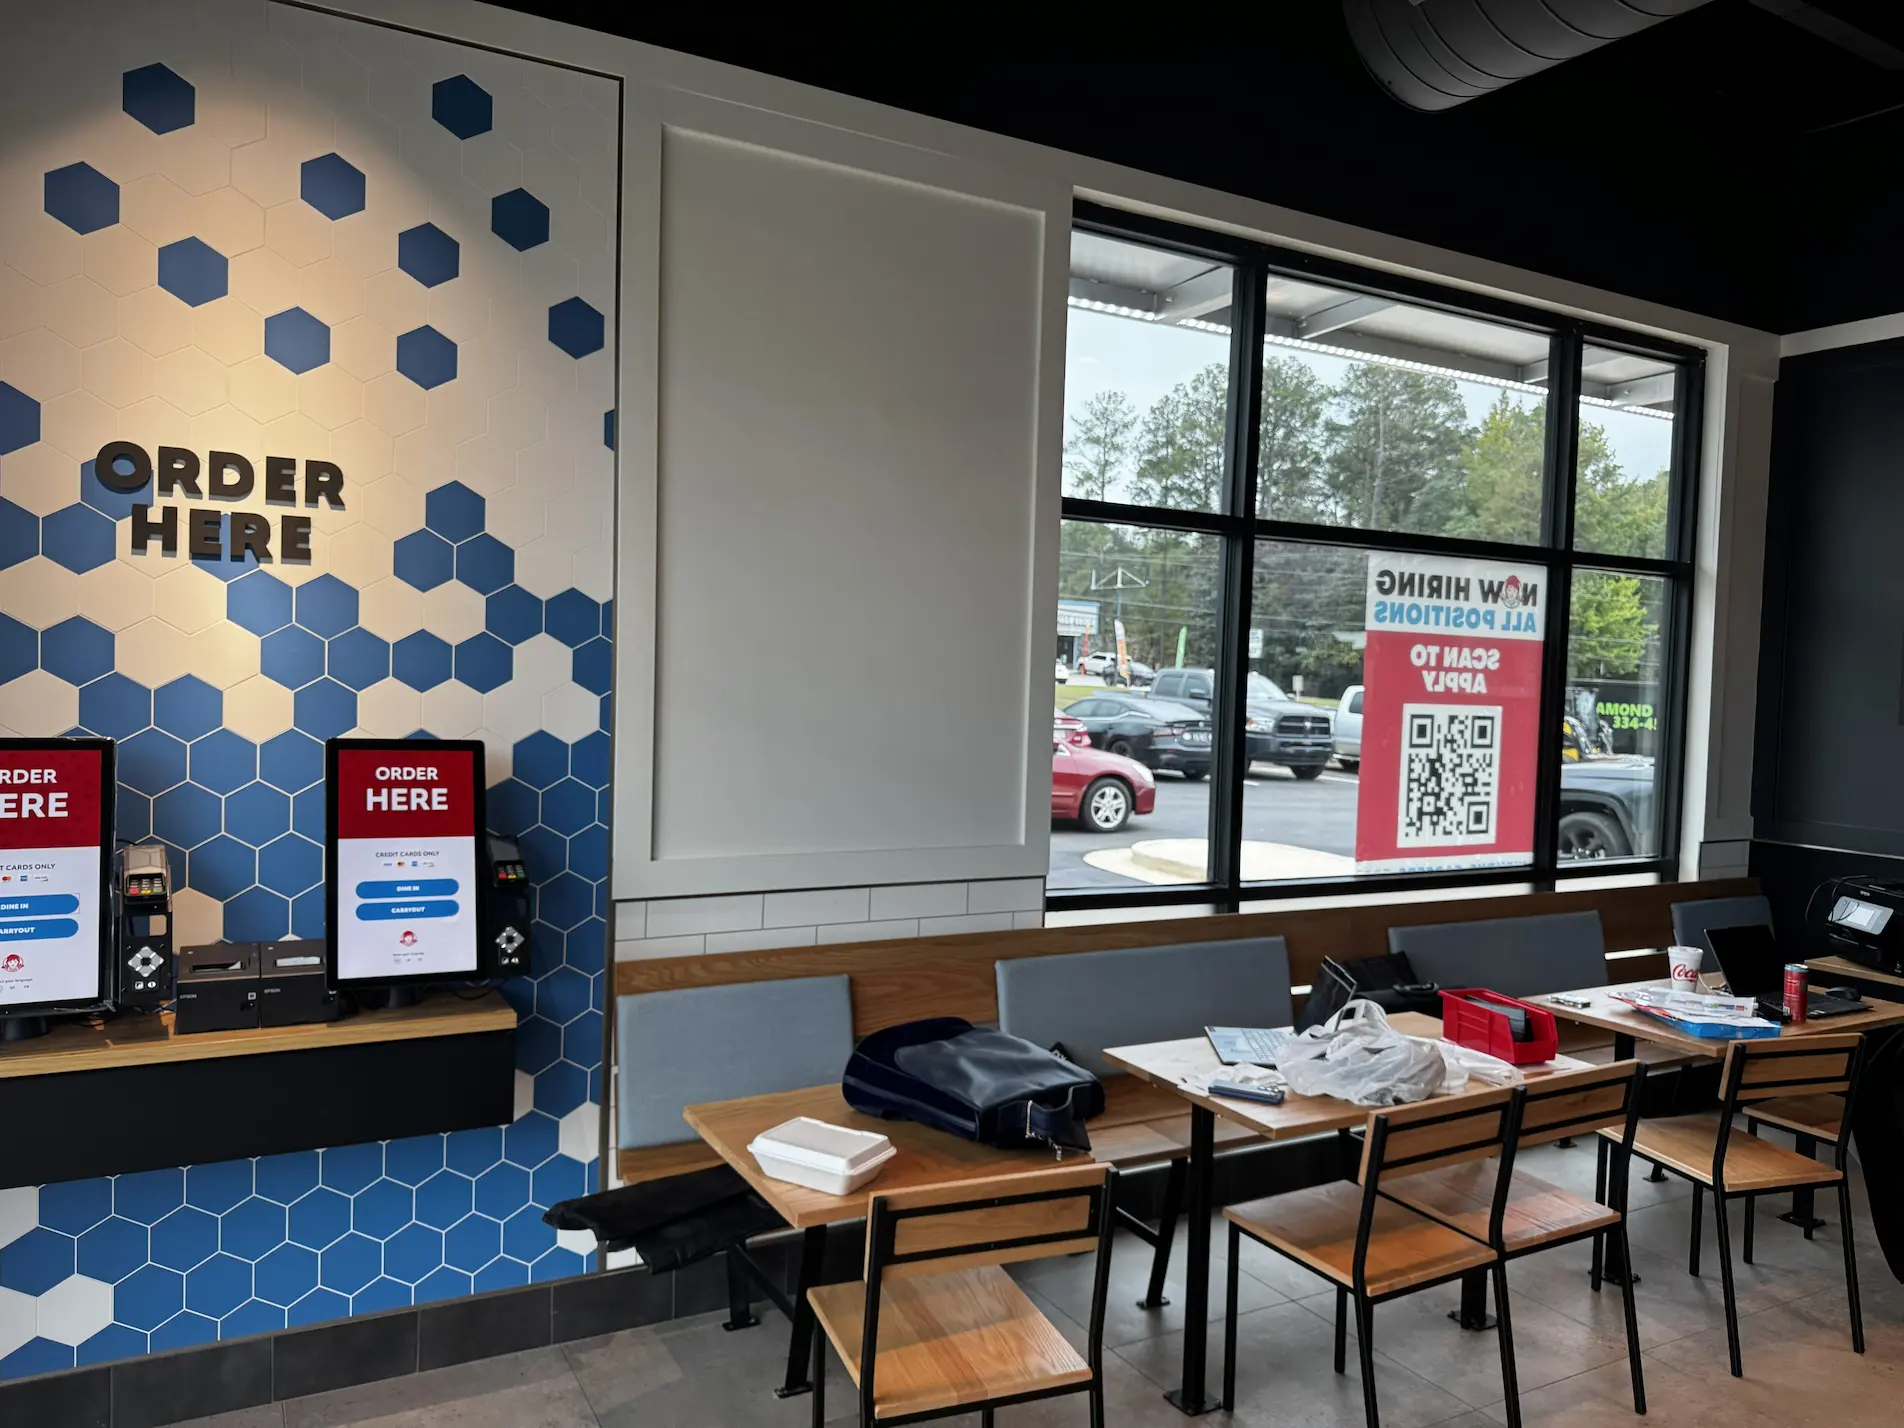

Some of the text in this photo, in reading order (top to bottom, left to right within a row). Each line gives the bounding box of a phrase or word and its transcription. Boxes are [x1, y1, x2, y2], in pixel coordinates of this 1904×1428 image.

[95, 441, 345, 510] ORDER
[131, 504, 311, 565] HERE
[1596, 702, 1653, 717] AMOND
[0, 768, 57, 784] RDER
[375, 766, 438, 780] ORDER
[0, 792, 68, 819] ERE
[366, 788, 449, 811] HERE
[0, 926, 35, 935] ARRYOUT
